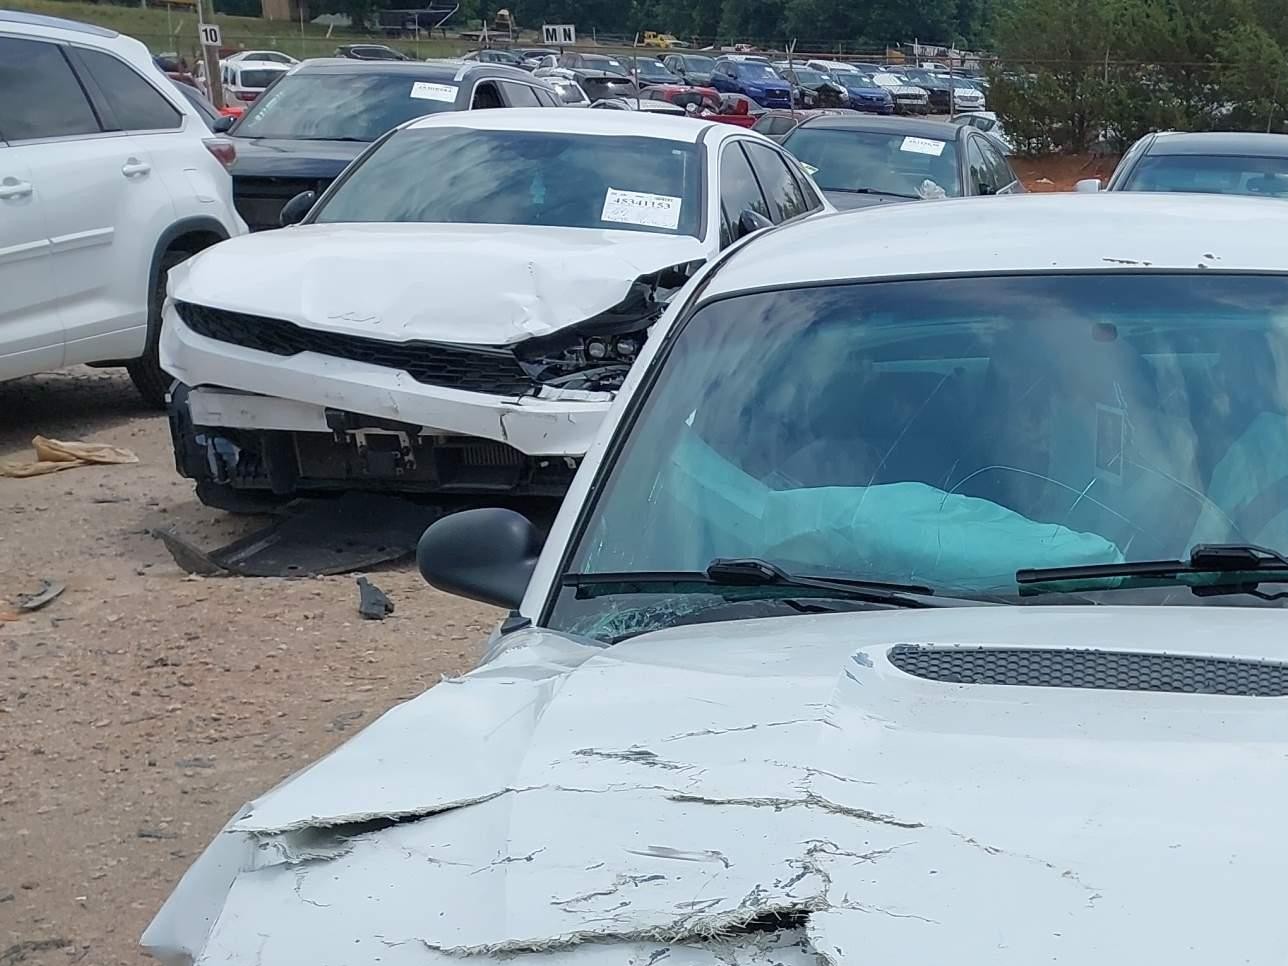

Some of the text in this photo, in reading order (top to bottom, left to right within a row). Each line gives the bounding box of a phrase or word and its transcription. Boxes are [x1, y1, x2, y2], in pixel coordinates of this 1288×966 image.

[202, 27, 218, 43] 10
[546, 27, 573, 42] M N
[613, 197, 671, 209] 45341153
